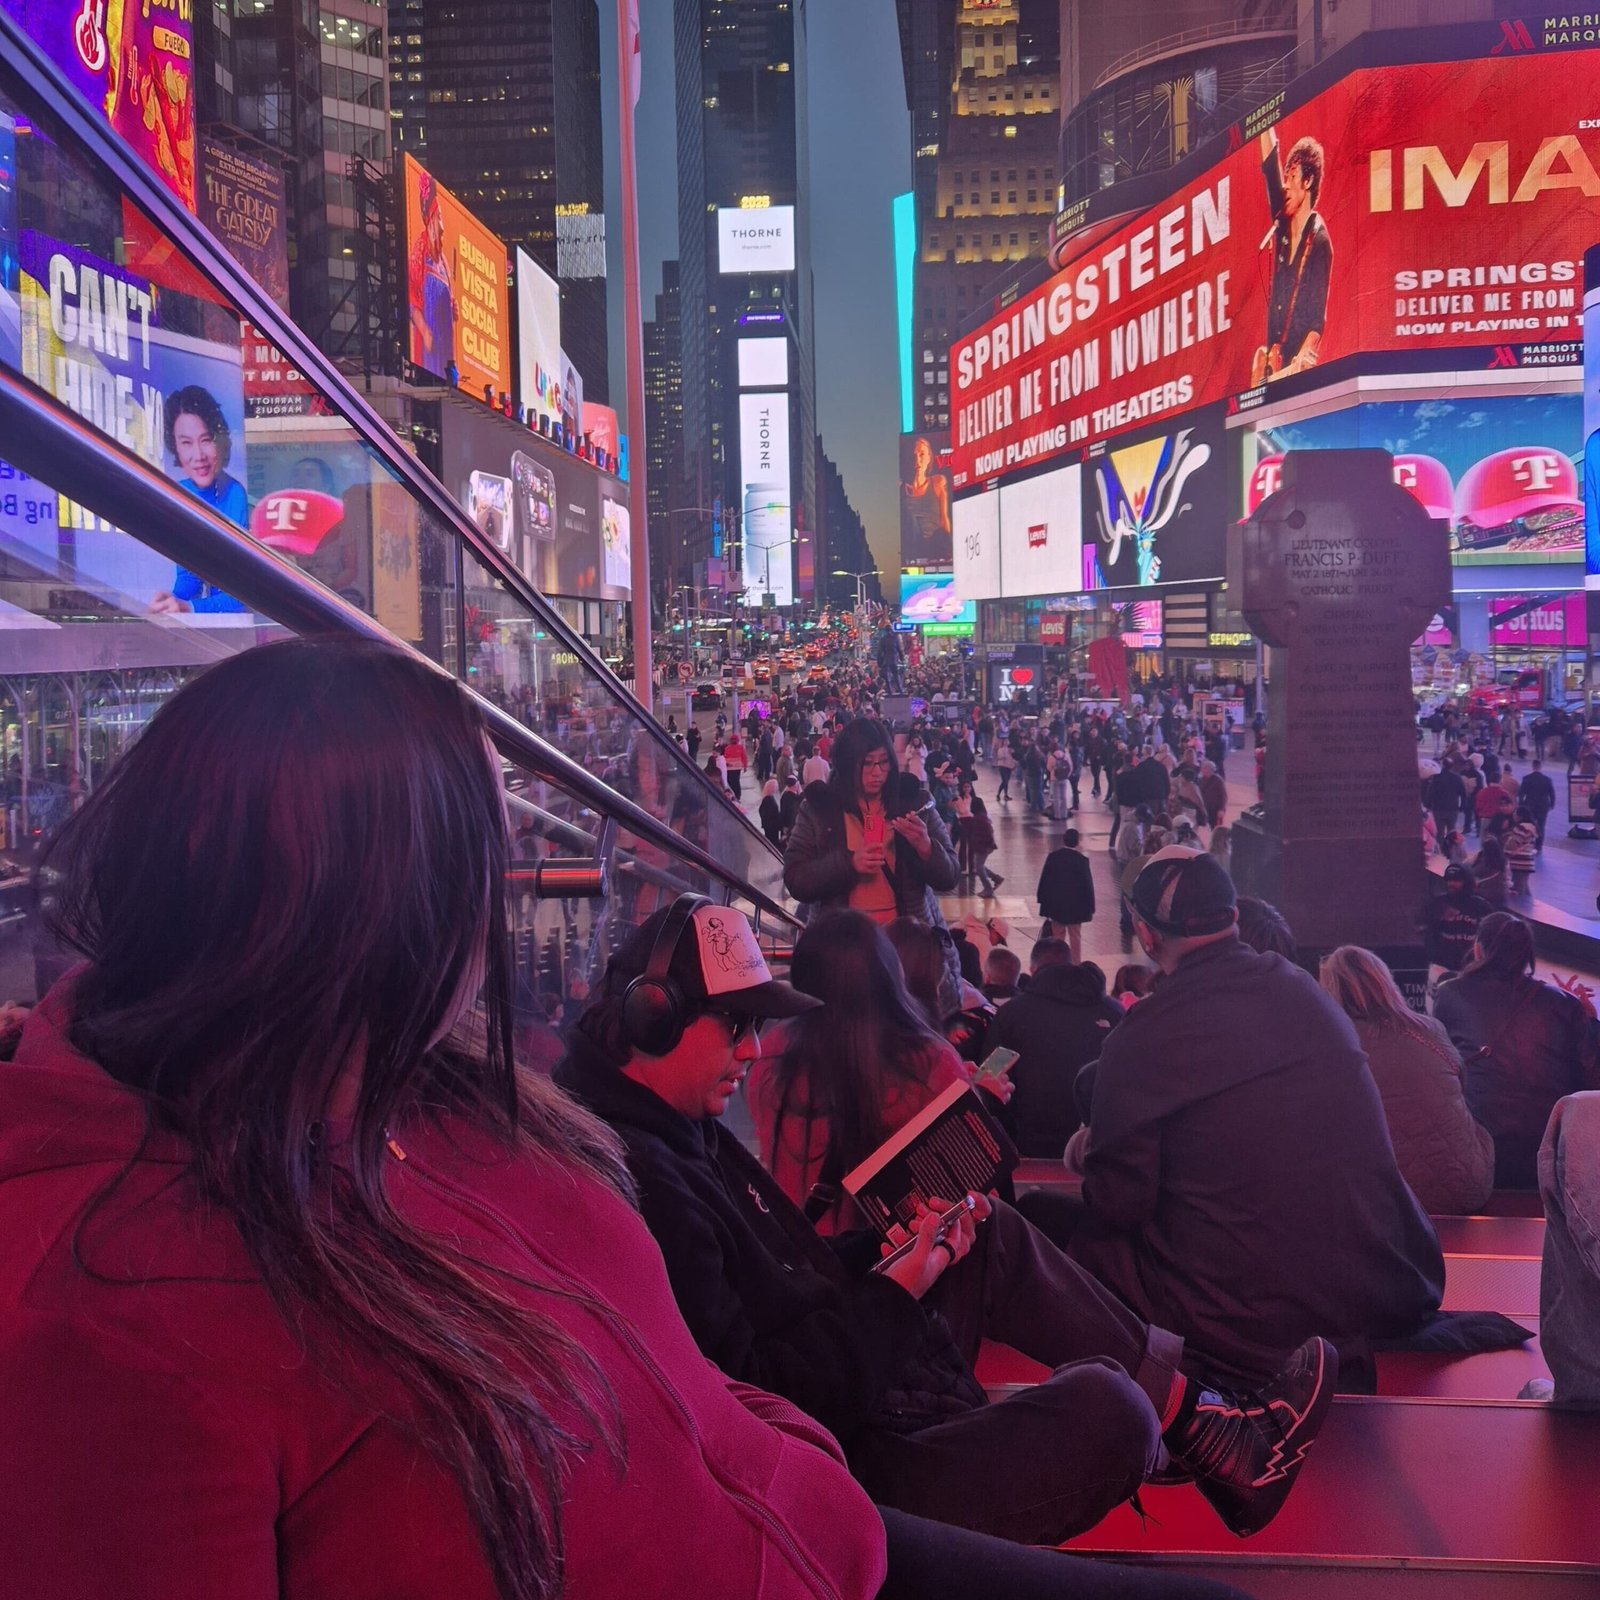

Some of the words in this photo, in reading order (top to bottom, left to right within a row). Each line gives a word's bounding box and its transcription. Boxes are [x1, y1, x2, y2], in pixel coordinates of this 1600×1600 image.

[1545, 14, 1600, 29] MARRI
[165, 33, 184, 54] FUEGO
[1246, 91, 1286, 126] MARRIOTT
[1246, 109, 1280, 139] MARQUIS
[219, 160, 267, 188] EXTRAVAGANZA
[234, 157, 246, 168] BIG
[246, 162, 279, 185] BROADWAY
[208, 180, 232, 208] THE
[234, 191, 278, 229] GREAT
[1057, 198, 1090, 226] MARRIOTT
[216, 206, 271, 246] GATSBY
[731, 228, 782, 239] THORNE
[1057, 213, 1085, 238] MARQUIS
[459, 233, 497, 285] BUENA
[460, 262, 498, 315] VISTA
[957, 175, 1231, 389] SPRINGSTEEN
[48, 253, 152, 370] CAN'T
[1395, 292, 1474, 318] DELIVER
[1484, 291, 1511, 313] ME
[1522, 287, 1575, 311] FROM
[461, 295, 499, 342] SOCIAL
[1396, 322, 1445, 337] NOW
[1451, 318, 1540, 334] PLAYING
[1546, 316, 1569, 328] IN
[462, 326, 500, 372] CLUB
[959, 388, 1013, 447] DELIVER
[1020, 368, 1042, 421] ME
[1050, 338, 1100, 407] FROM
[1110, 270, 1232, 380] NOWHERE
[1523, 343, 1584, 354] MARRIOTT
[1523, 353, 1578, 364] MARQUIS
[760, 408, 770, 469] THORNE
[975, 449, 1004, 477] NOW
[1007, 422, 1067, 467] PLAYING
[1071, 415, 1089, 442] IN
[1092, 374, 1194, 435] THEATERS
[965, 532, 980, 560] 196
[1284, 552, 1344, 567] FRANCIS
[1362, 550, 1410, 566] DUFFY
[1292, 538, 1351, 551] LIEUTENANT
[1291, 569, 1312, 579] MAY
[1300, 585, 1353, 596] CATHOLIC
[1358, 584, 1395, 594] PRIEST
[1001, 668, 1011, 685] I
[1404, 984, 1425, 994] TIM
